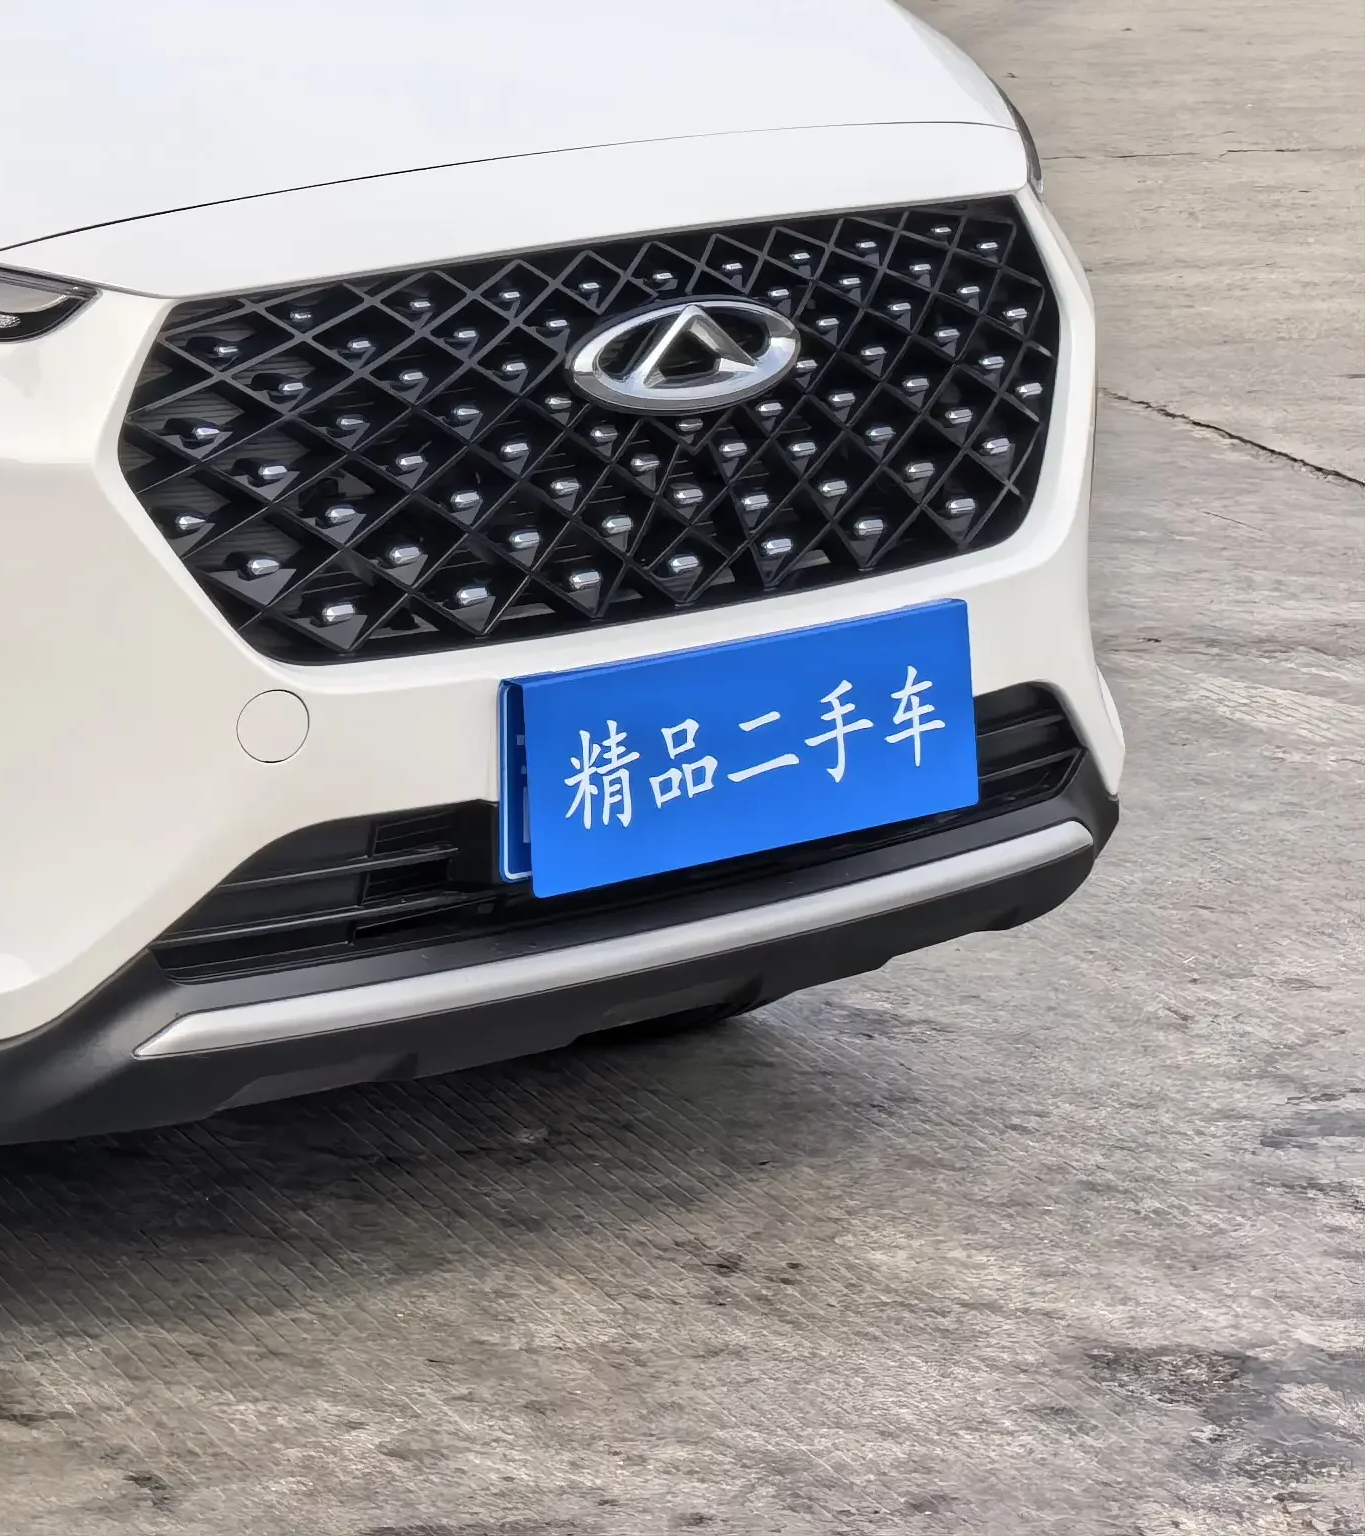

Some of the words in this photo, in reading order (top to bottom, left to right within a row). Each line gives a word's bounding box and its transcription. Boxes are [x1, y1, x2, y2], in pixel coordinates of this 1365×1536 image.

[564, 666, 946, 830] 精品二手车
